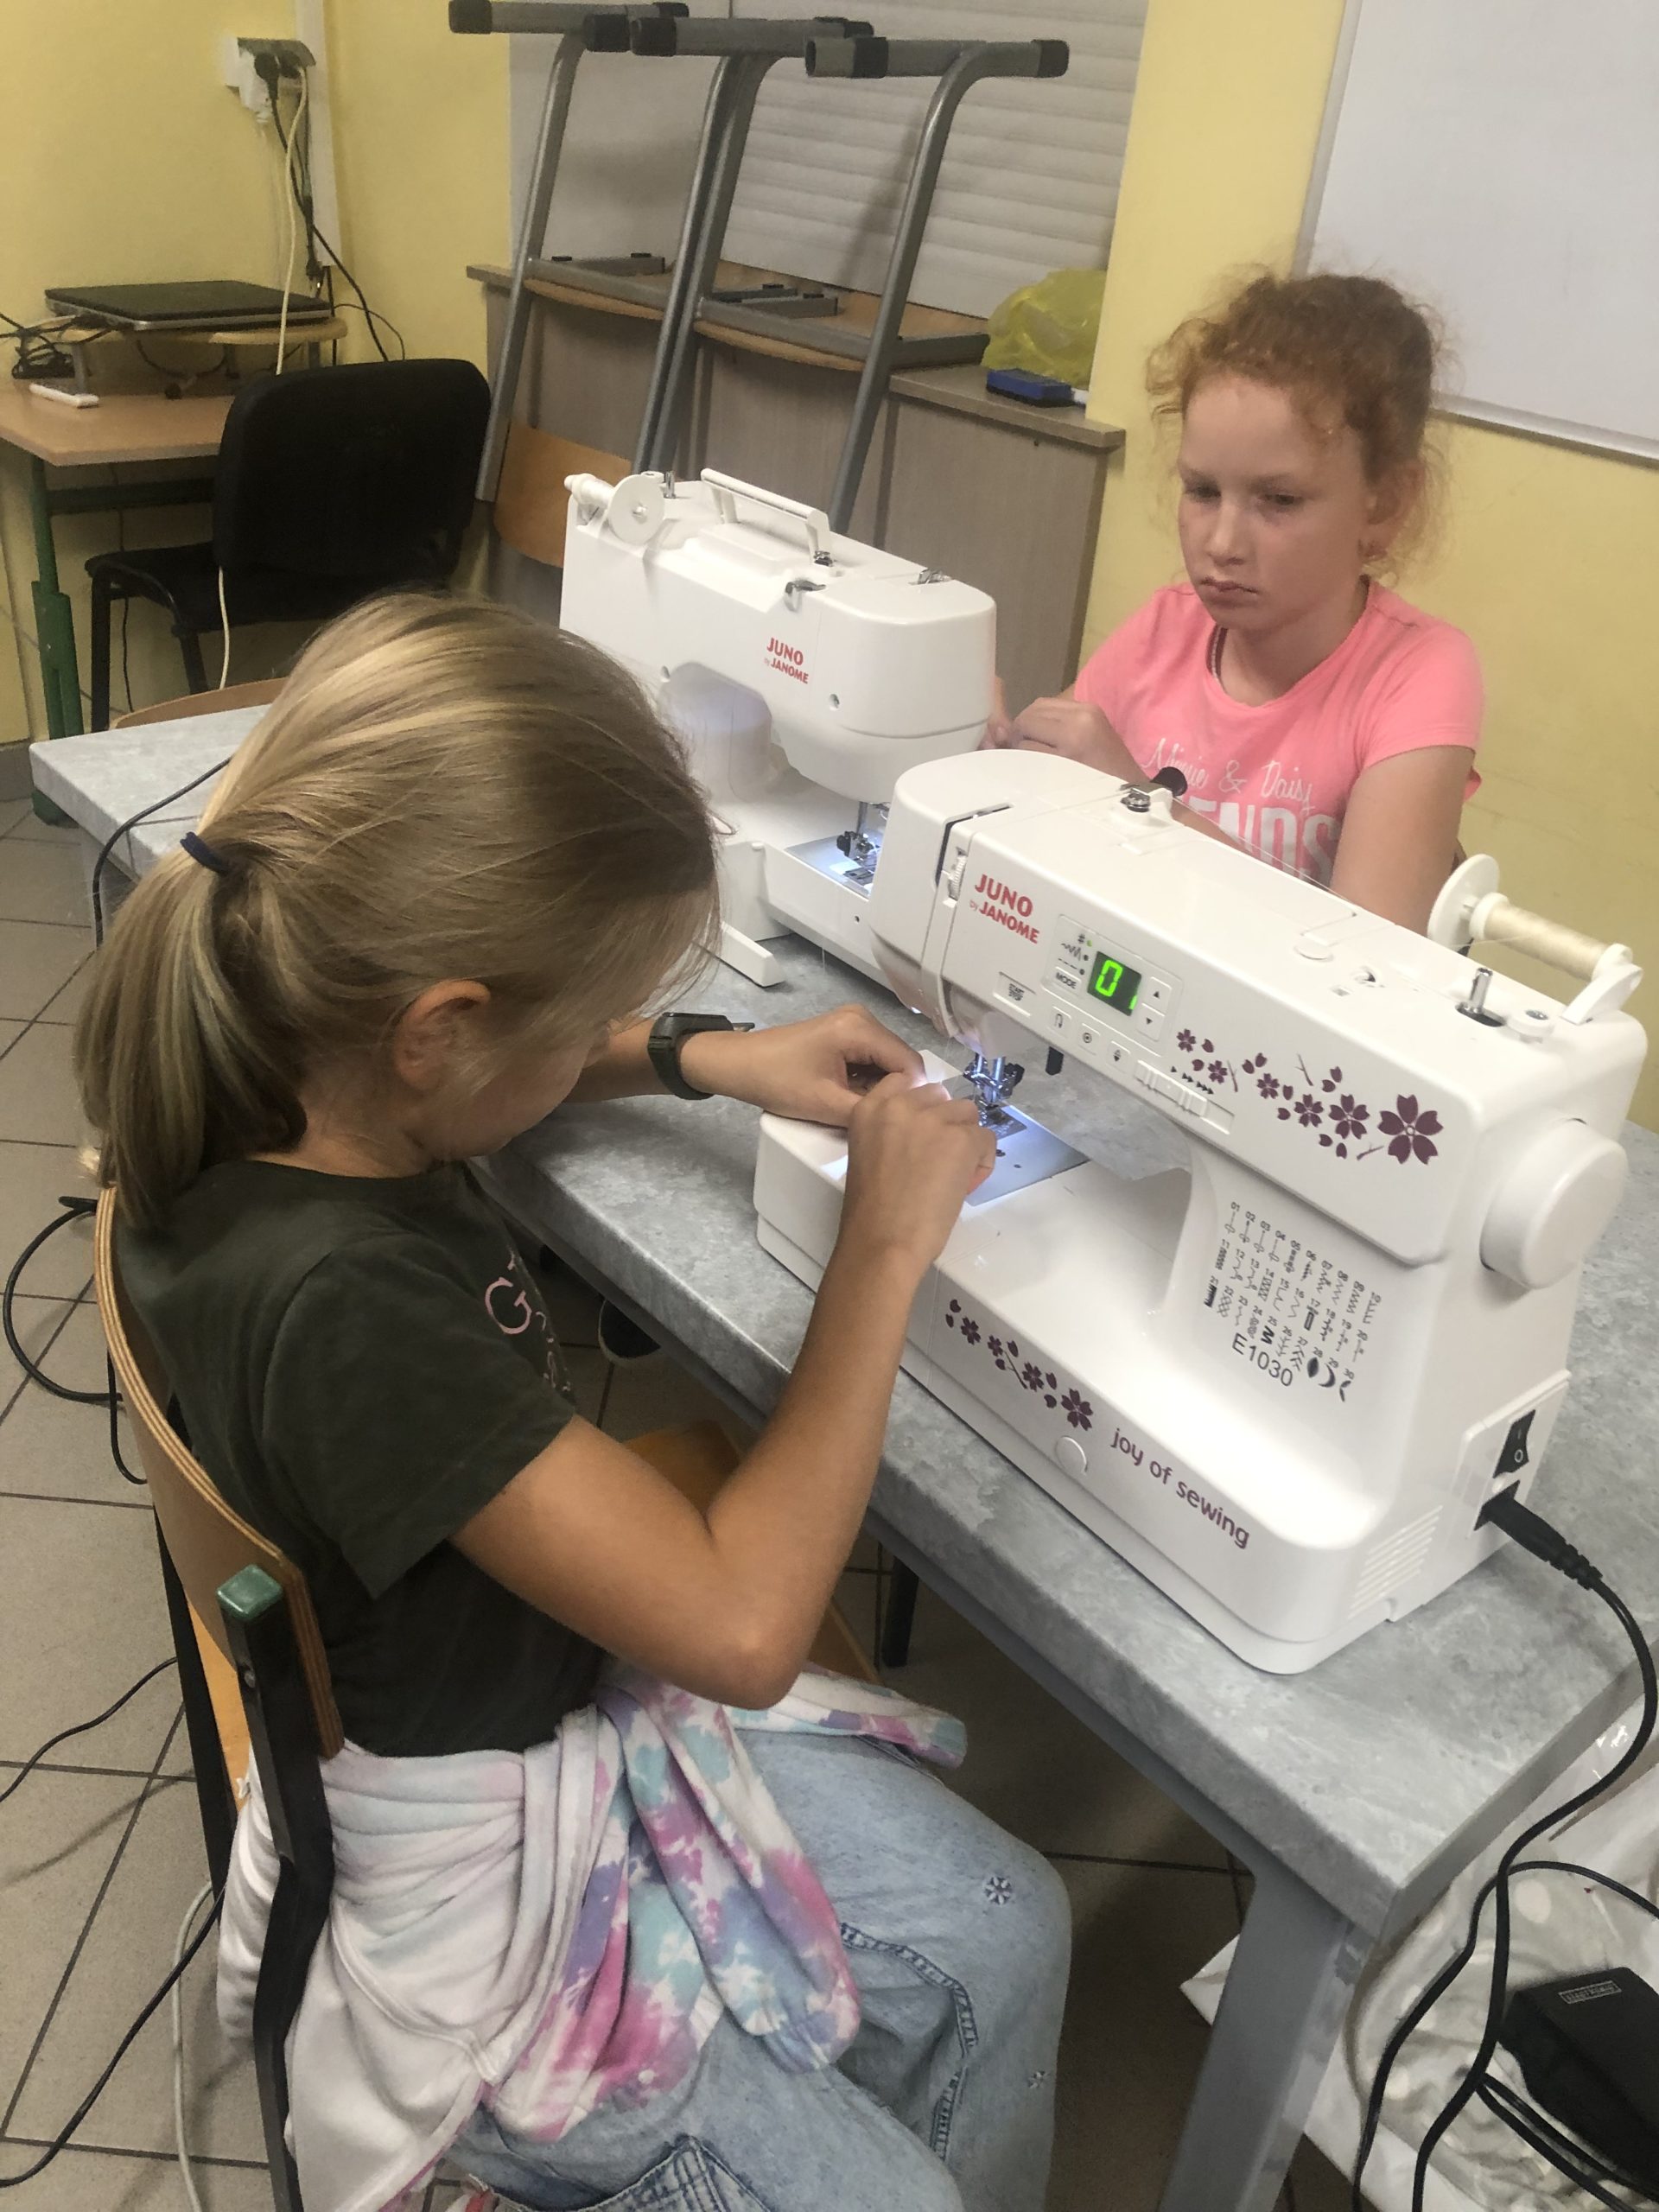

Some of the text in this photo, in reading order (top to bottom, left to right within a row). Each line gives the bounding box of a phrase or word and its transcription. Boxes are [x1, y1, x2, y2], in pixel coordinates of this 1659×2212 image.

[767, 638, 804, 665] JUNO
[771, 658, 809, 684] JANOME
[1218, 760, 1247, 794] &
[1261, 760, 1316, 816] Daisy
[975, 874, 1033, 917] JUNO
[979, 901, 1039, 944] JANOME
[1056, 972, 1077, 989] MODE
[1222, 1239, 1368, 1341] 11 12 13 14 15 16 17 18 19 20
[1211, 1275, 1354, 1380] 21 22 23 24 25 26 27 28 29 30
[1232, 1332, 1293, 1387] E1030
[1110, 1427, 1250, 1549] joy of sewing
